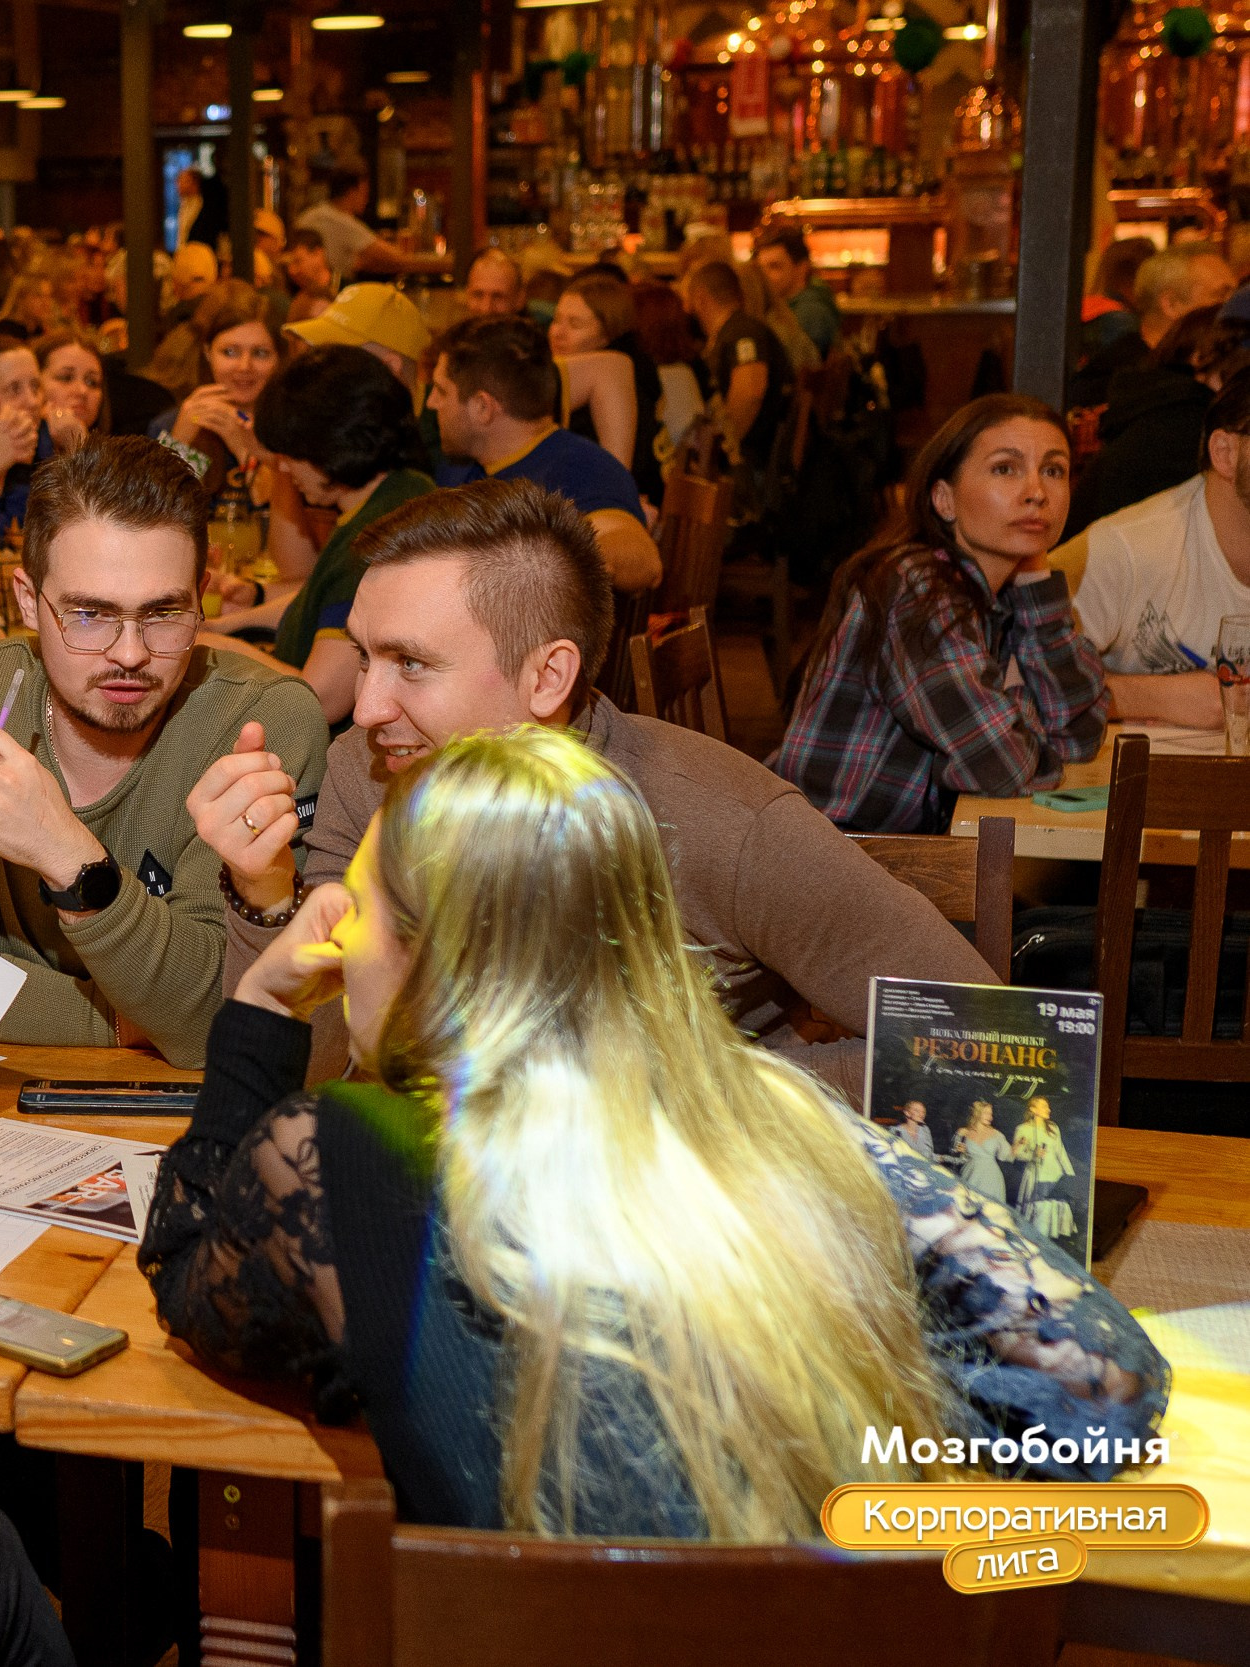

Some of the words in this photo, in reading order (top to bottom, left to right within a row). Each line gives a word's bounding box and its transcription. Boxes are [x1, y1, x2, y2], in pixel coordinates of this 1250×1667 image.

[1037, 1002, 1058, 1017] 19
[1059, 1006, 1096, 1021] мая
[1056, 1020, 1096, 1036] 19:00
[913, 1036, 1057, 1069] РЕЗОНАНС
